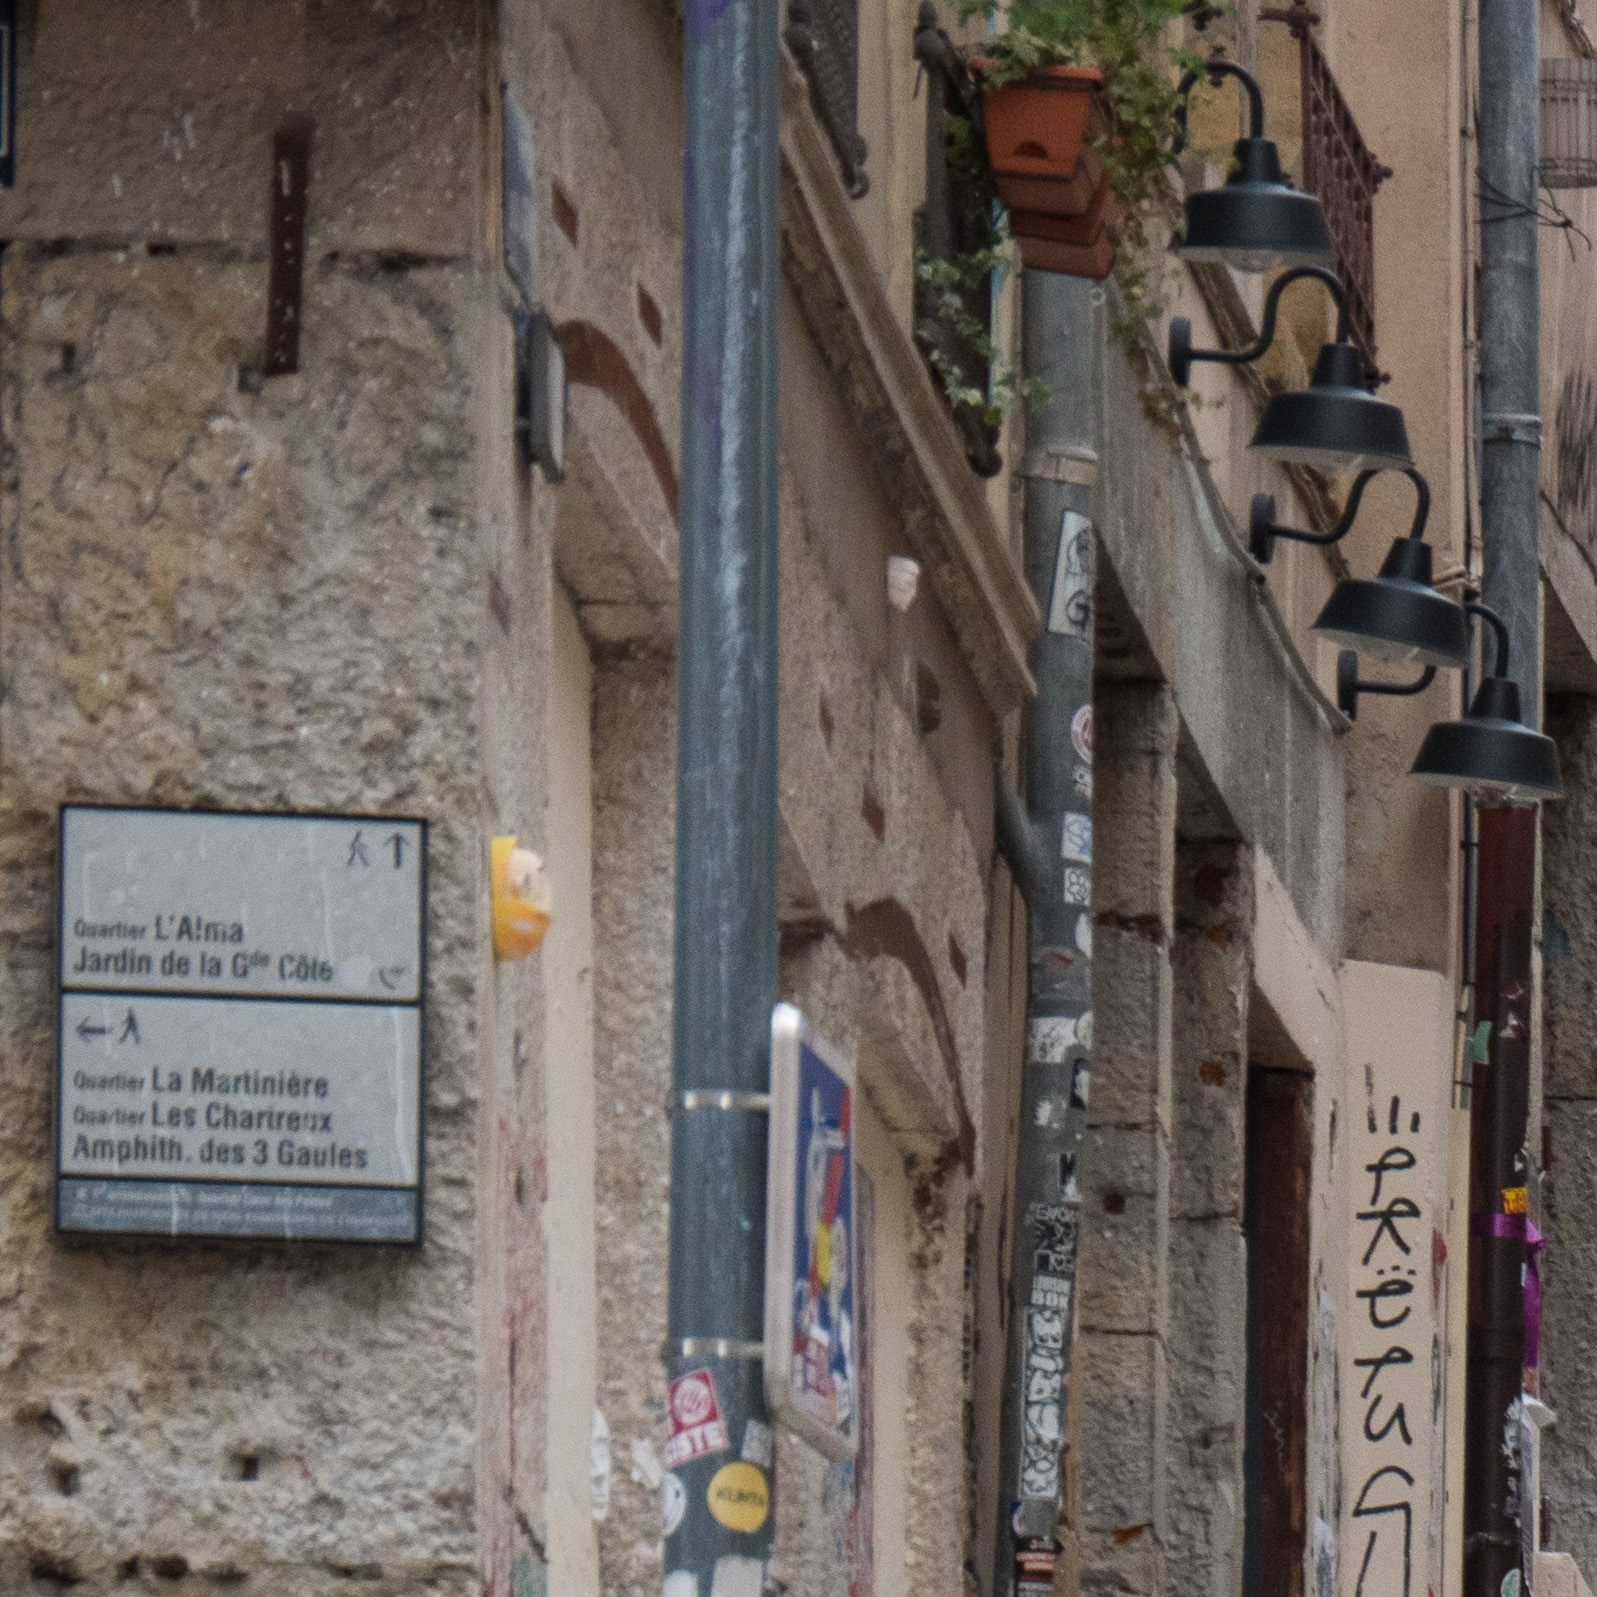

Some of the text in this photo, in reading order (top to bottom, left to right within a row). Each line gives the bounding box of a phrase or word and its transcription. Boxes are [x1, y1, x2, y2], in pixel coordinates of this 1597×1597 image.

[73, 914, 244, 943] Quartier L'Alma
[73, 946, 151, 975] Jardin
[160, 950, 190, 976] de
[201, 951, 222, 977] la
[73, 1065, 330, 1099] Quartier La Martinière
[73, 1101, 334, 1133] Quartier Les Chartreux
[72, 1133, 369, 1170] Amphith. des 3 Gaules
